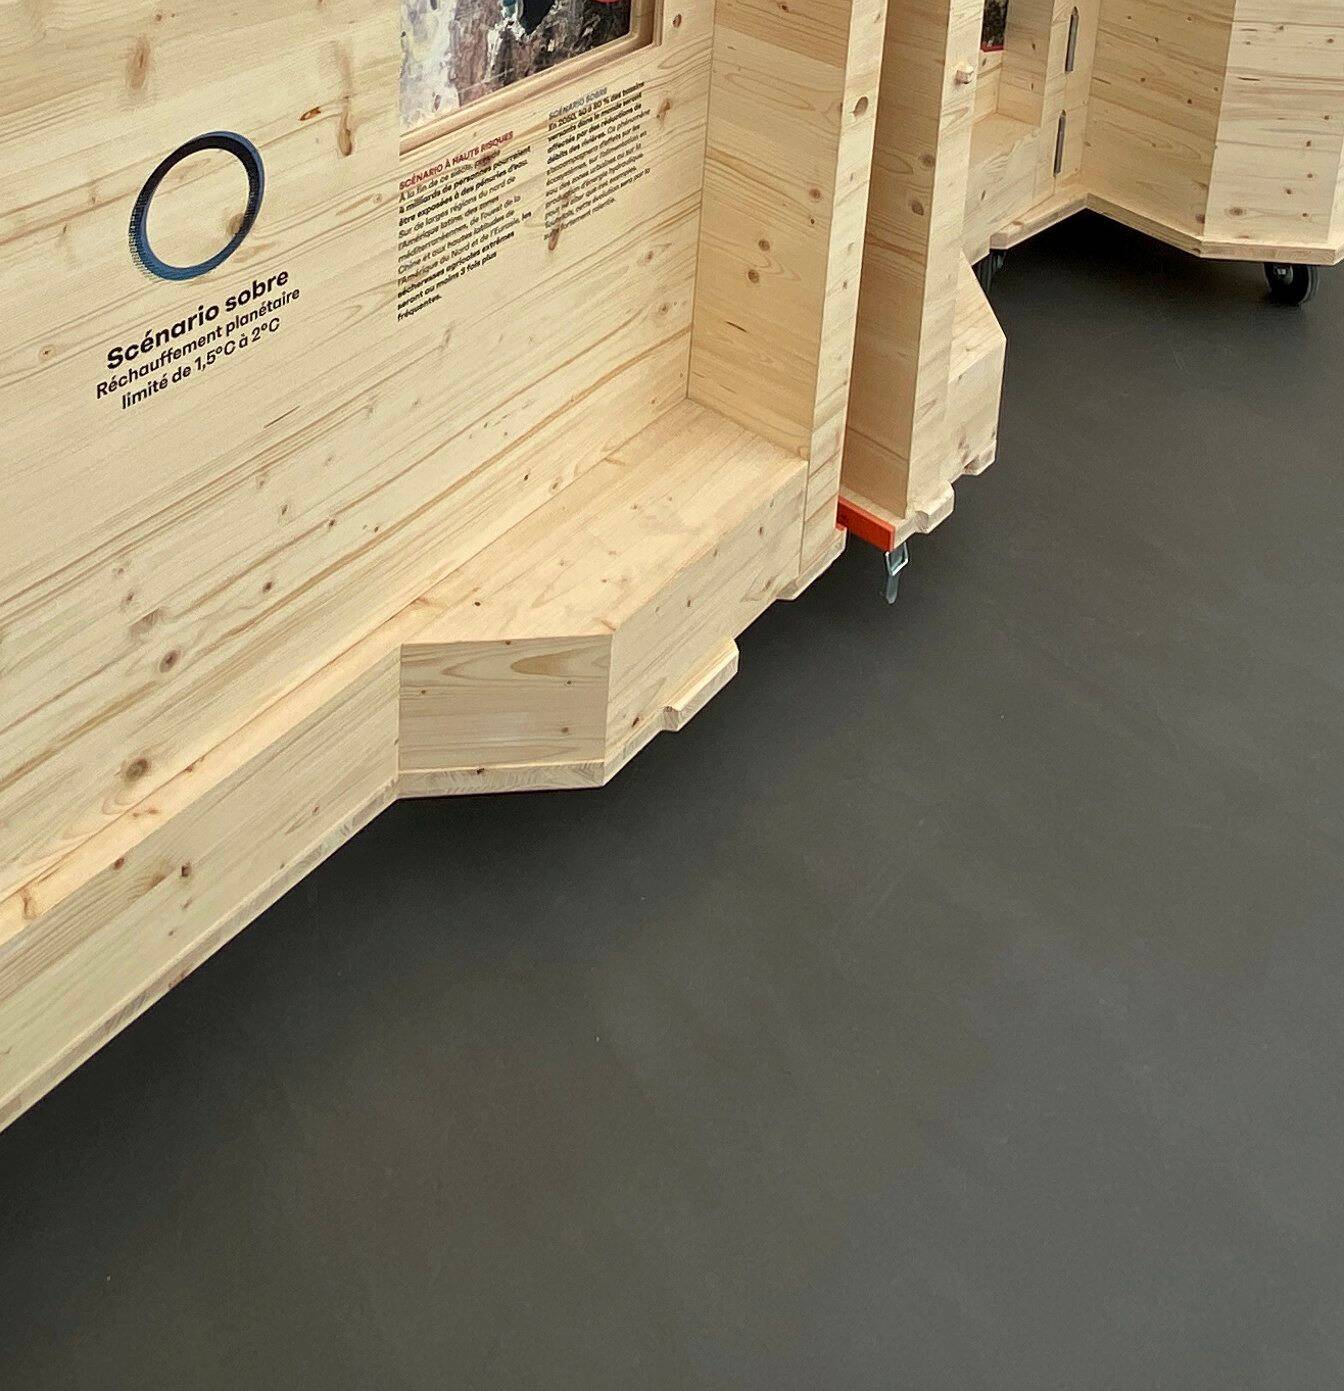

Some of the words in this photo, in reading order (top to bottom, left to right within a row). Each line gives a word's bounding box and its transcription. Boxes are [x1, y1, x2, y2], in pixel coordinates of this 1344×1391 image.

[96, 325, 223, 400] Réchauffement
[225, 288, 300, 338] planétaire
[106, 304, 220, 370] Scénario
[225, 270, 289, 313] sobre
